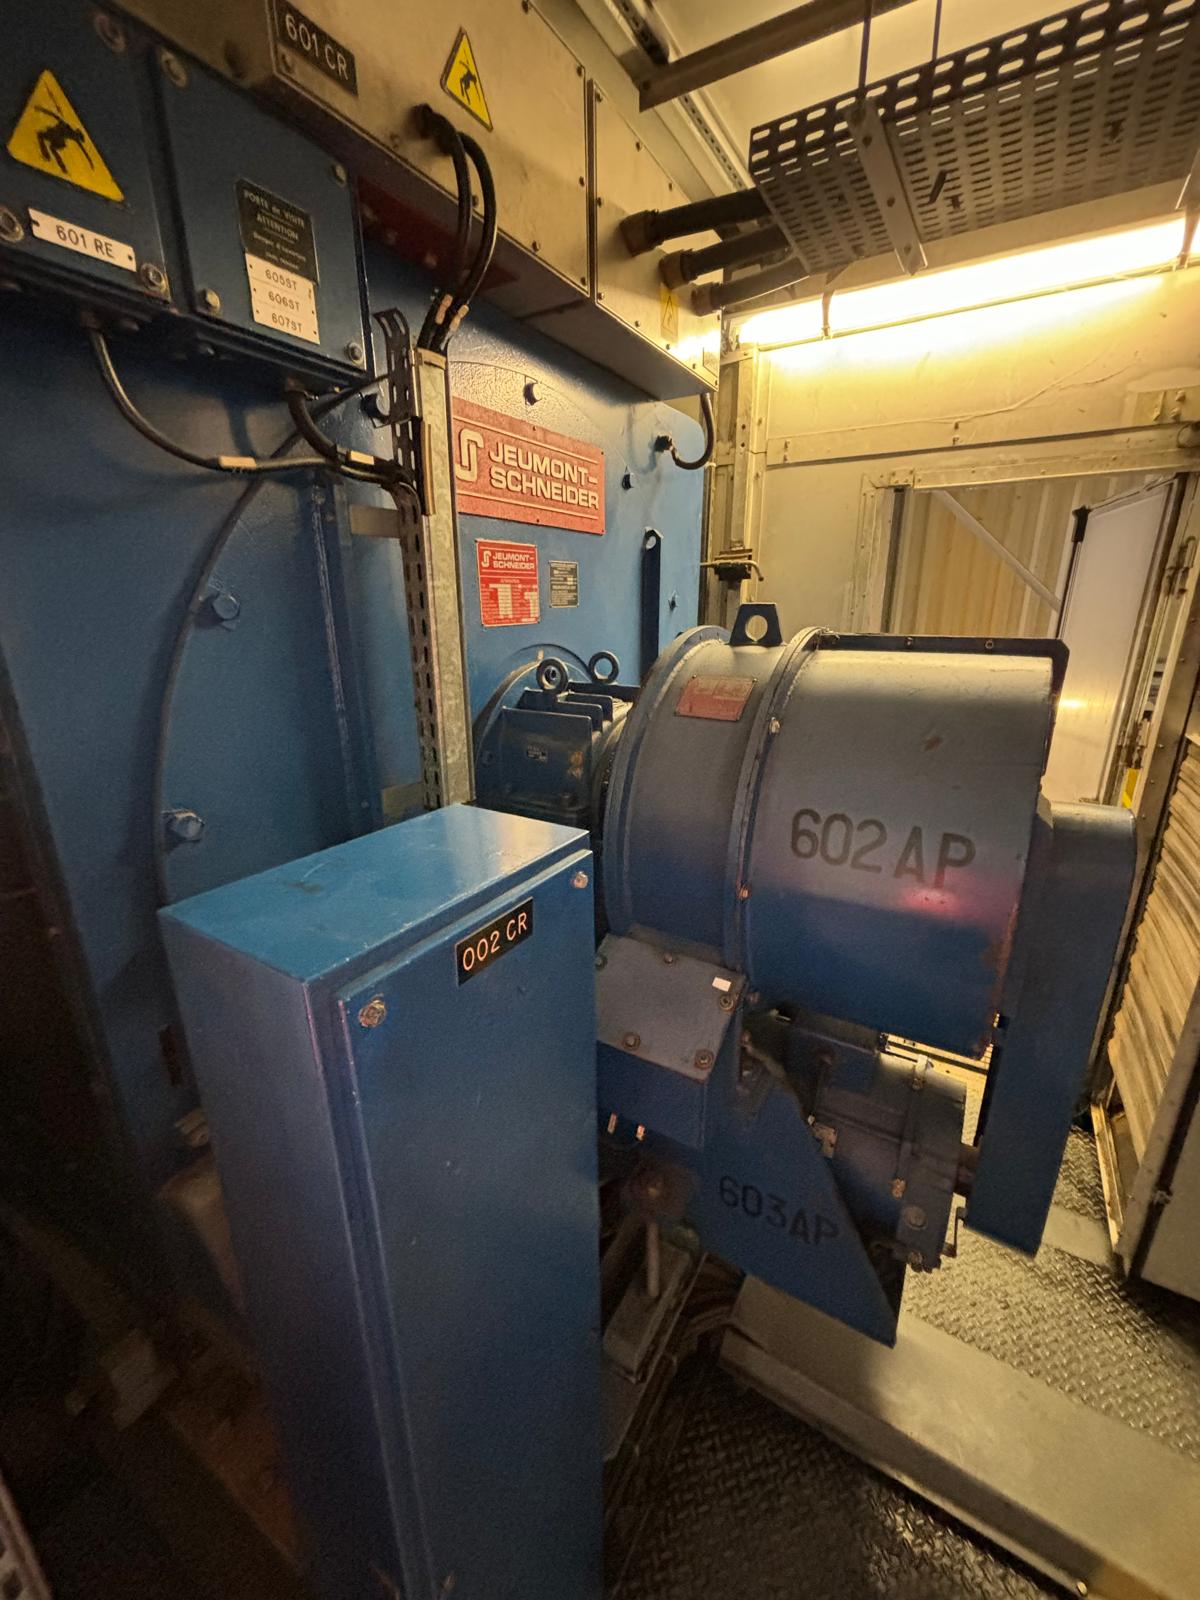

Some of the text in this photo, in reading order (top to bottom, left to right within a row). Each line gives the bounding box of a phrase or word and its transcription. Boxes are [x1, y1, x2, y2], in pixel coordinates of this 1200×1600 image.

[286, 13, 349, 81] 601 CR
[56, 224, 115, 259] 601 RE
[256, 213, 299, 241] ATTENTION
[265, 269, 297, 291] 605ST
[268, 290, 300, 311] 606ST
[271, 312, 303, 333] 607ST
[488, 441, 598, 486] JEUMONT-
[489, 465, 599, 510] SCHNEIDER
[492, 560, 535, 570] SCHNEIDER
[462, 912, 528, 971] 002 CR
